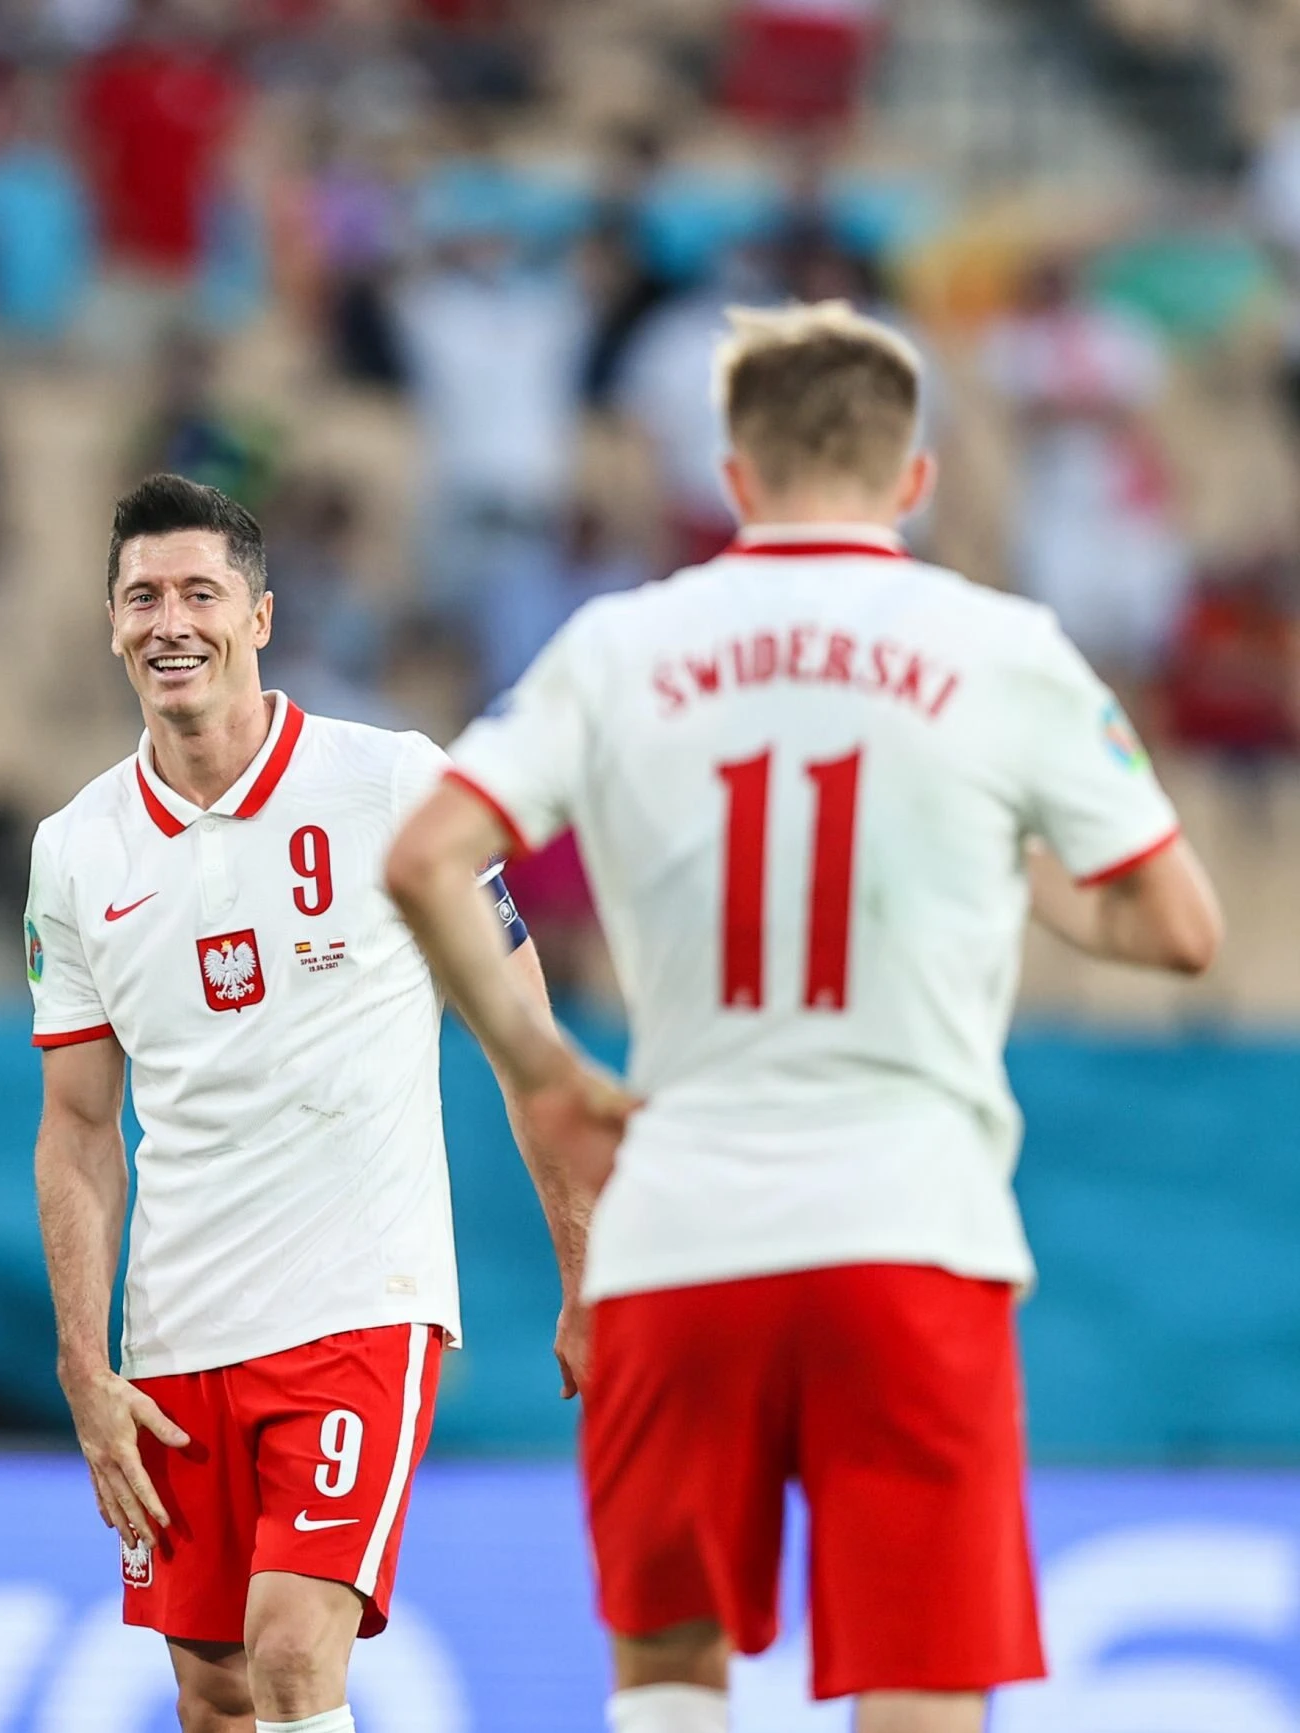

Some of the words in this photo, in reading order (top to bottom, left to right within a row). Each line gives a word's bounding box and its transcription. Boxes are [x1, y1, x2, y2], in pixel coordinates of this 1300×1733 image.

[289, 824, 333, 917] 9
[715, 742, 863, 1014] 11
[300, 957, 318, 966] SPAIN
[321, 952, 345, 962] POLAND
[314, 1408, 364, 1498] 9
